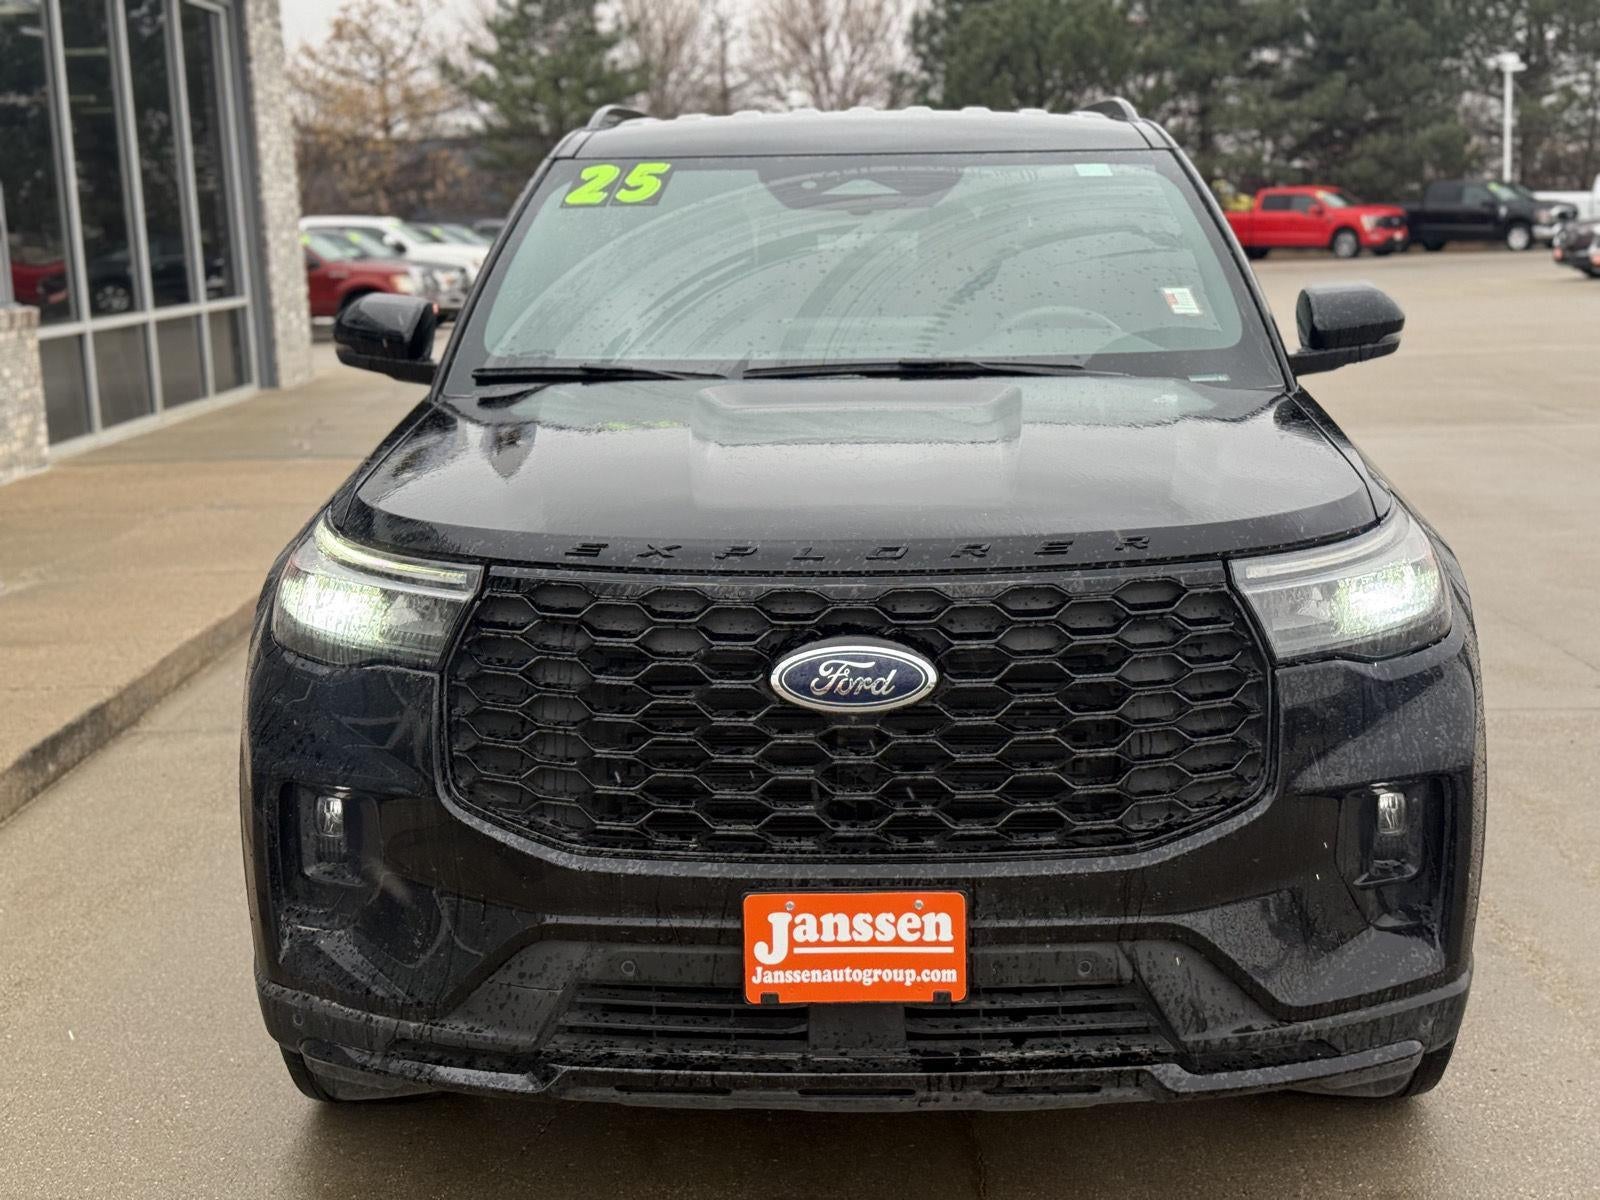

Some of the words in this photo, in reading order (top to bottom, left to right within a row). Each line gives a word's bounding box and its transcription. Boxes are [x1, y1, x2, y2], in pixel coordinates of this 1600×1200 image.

[565, 163, 671, 205] 25
[564, 535, 1150, 561] EXPLORER
[810, 659, 897, 696] Ford
[753, 911, 954, 965] Janssen
[752, 966, 957, 986] Janssenautogroup.com
